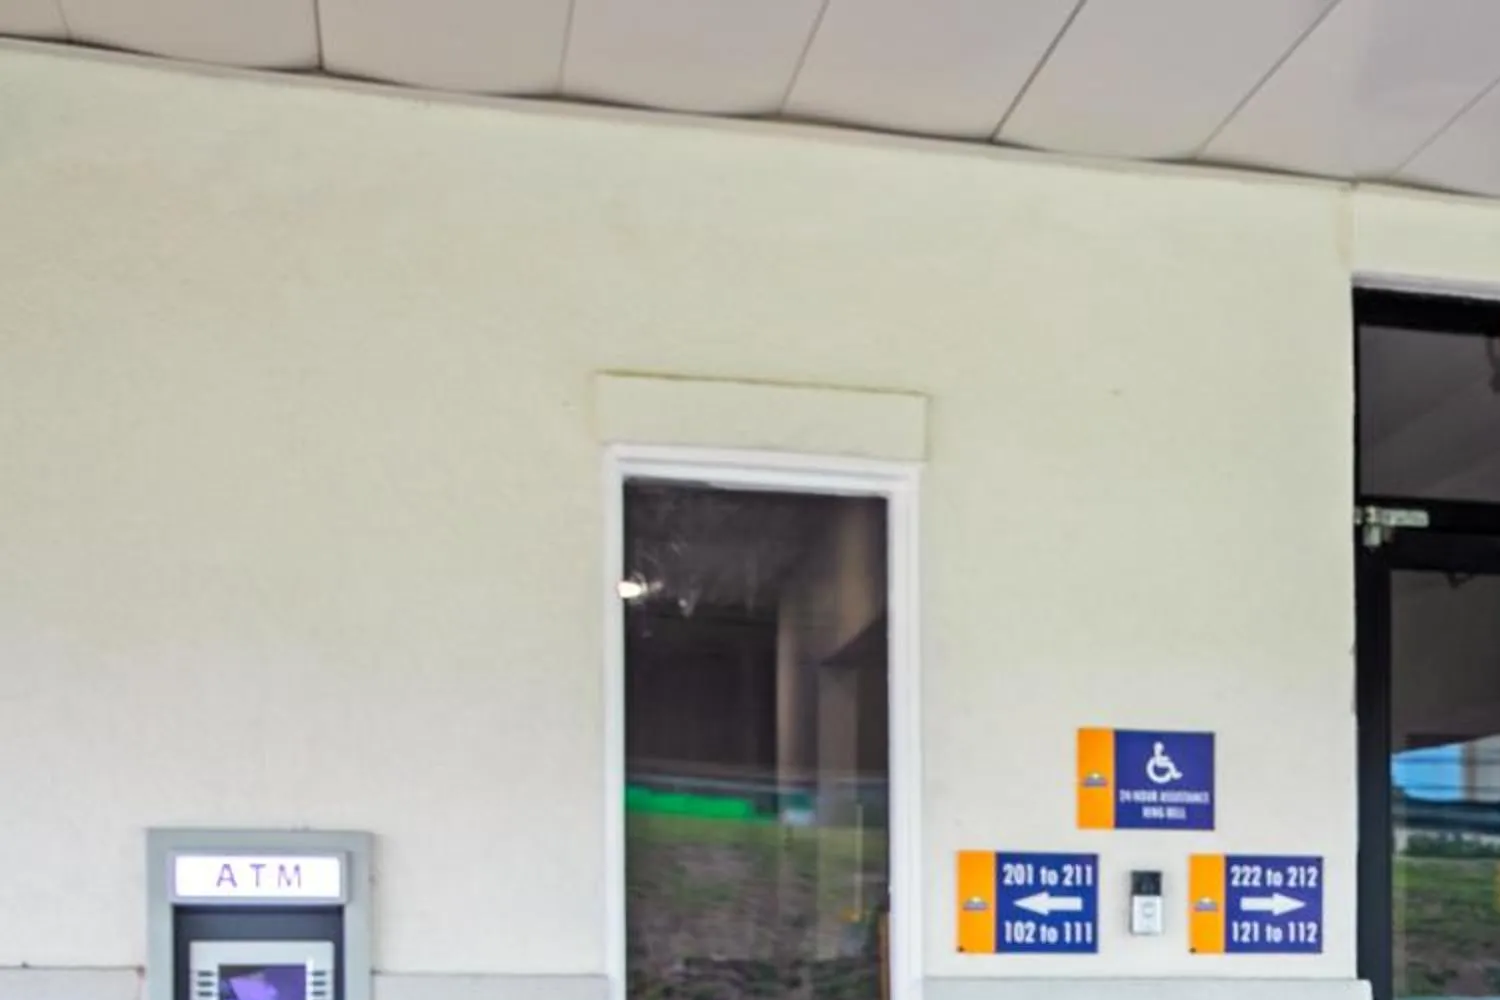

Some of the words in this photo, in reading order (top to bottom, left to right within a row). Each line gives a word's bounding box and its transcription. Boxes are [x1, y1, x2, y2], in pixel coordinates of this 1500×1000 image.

[216, 863, 302, 888] ATM
[1002, 863, 1034, 886] 201
[1040, 866, 1059, 886] to
[1062, 864, 1093, 887] 211
[1231, 864, 1262, 887] 222
[1266, 867, 1284, 887] to
[1287, 866, 1318, 888] 212
[1004, 920, 1036, 944] 102
[1040, 923, 1058, 944] to
[1063, 921, 1093, 944] 111
[1231, 921, 1260, 943] 121
[1265, 924, 1284, 943] to
[1287, 921, 1318, 943] 112
